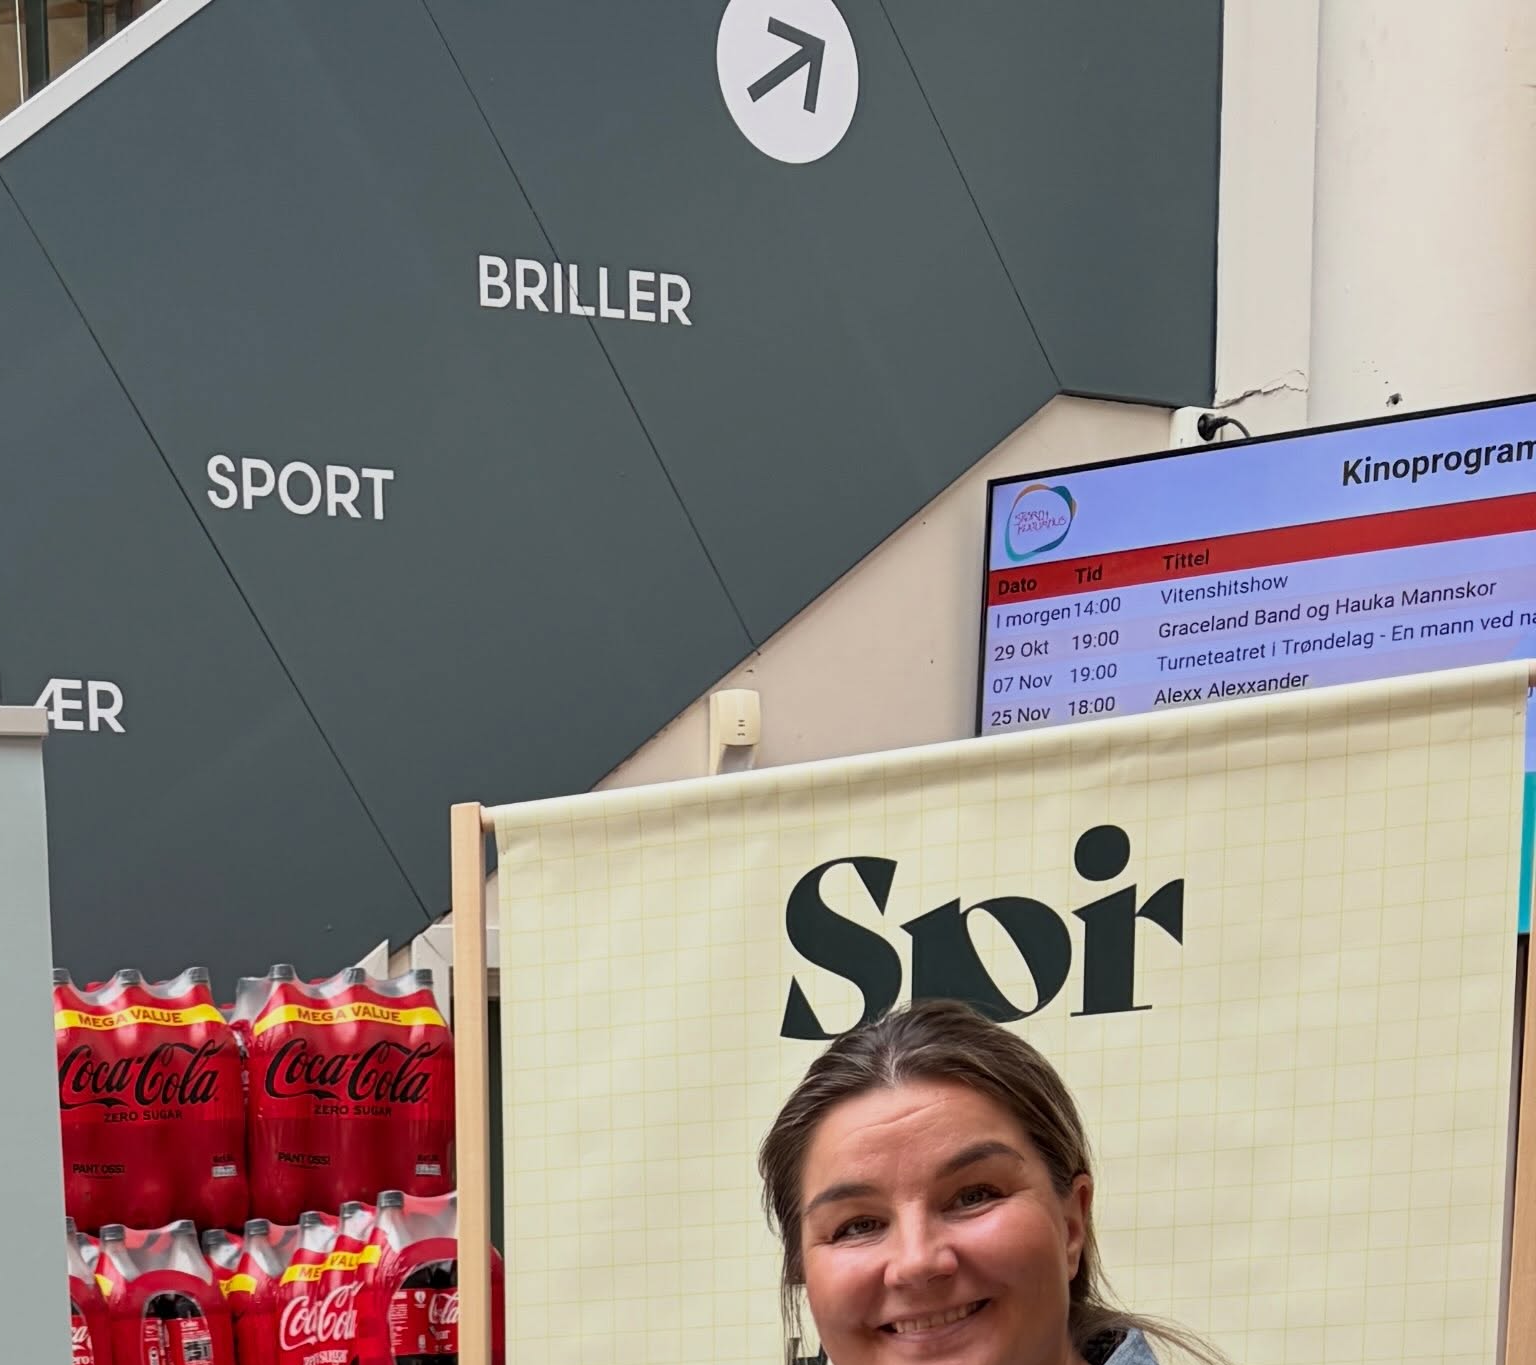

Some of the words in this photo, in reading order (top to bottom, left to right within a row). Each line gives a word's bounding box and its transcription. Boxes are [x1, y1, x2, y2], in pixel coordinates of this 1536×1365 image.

[477, 254, 691, 325] BRILLER
[207, 454, 393, 520] SPORT
[1343, 440, 1536, 486] Kinoprogram
[998, 578, 1036, 595] Dato
[1075, 565, 1102, 584] Tid
[1163, 550, 1210, 570] Tittel
[994, 644, 1014, 662] 29
[1021, 640, 1049, 657] Okt
[1072, 630, 1119, 650] 19:00
[1159, 611, 1248, 638] Graceland
[1255, 604, 1300, 625] Band
[1307, 604, 1329, 620] og
[1336, 594, 1394, 615] Hauka
[1402, 582, 1497, 606] Mannskor
[996, 614, 1000, 628] I
[1006, 607, 1070, 627] morgen
[1074, 597, 1120, 617] 14:00
[1162, 576, 1288, 604] Vitenshitshow
[993, 678, 1013, 694] 07
[1020, 674, 1052, 690] Nov
[1070, 663, 1117, 683] 19:00
[1158, 644, 1266, 672] Turneteatret
[1272, 641, 1276, 656] i
[1283, 631, 1374, 655] Trøndelag
[1392, 626, 1413, 641] En
[1420, 619, 1473, 637] mann
[1480, 610, 1513, 630] ved
[992, 710, 1012, 726] 25
[1018, 707, 1050, 723] Nov
[1069, 697, 1115, 716] 18:00
[1154, 685, 1202, 705] Alexx
[1208, 672, 1308, 700] Alexxander
[79, 1013, 128, 1028] MEGA
[130, 1007, 183, 1024] VALUE
[297, 1007, 346, 1022] MEGA
[351, 1005, 402, 1023] VALUE
[60, 1039, 226, 1110] Coca-Cola
[265, 1038, 445, 1104] Coca-Cola
[104, 1111, 138, 1123] ZERO
[143, 1110, 183, 1121] SUGAR
[315, 1105, 349, 1116] ZERO
[353, 1104, 392, 1117] SUGAR
